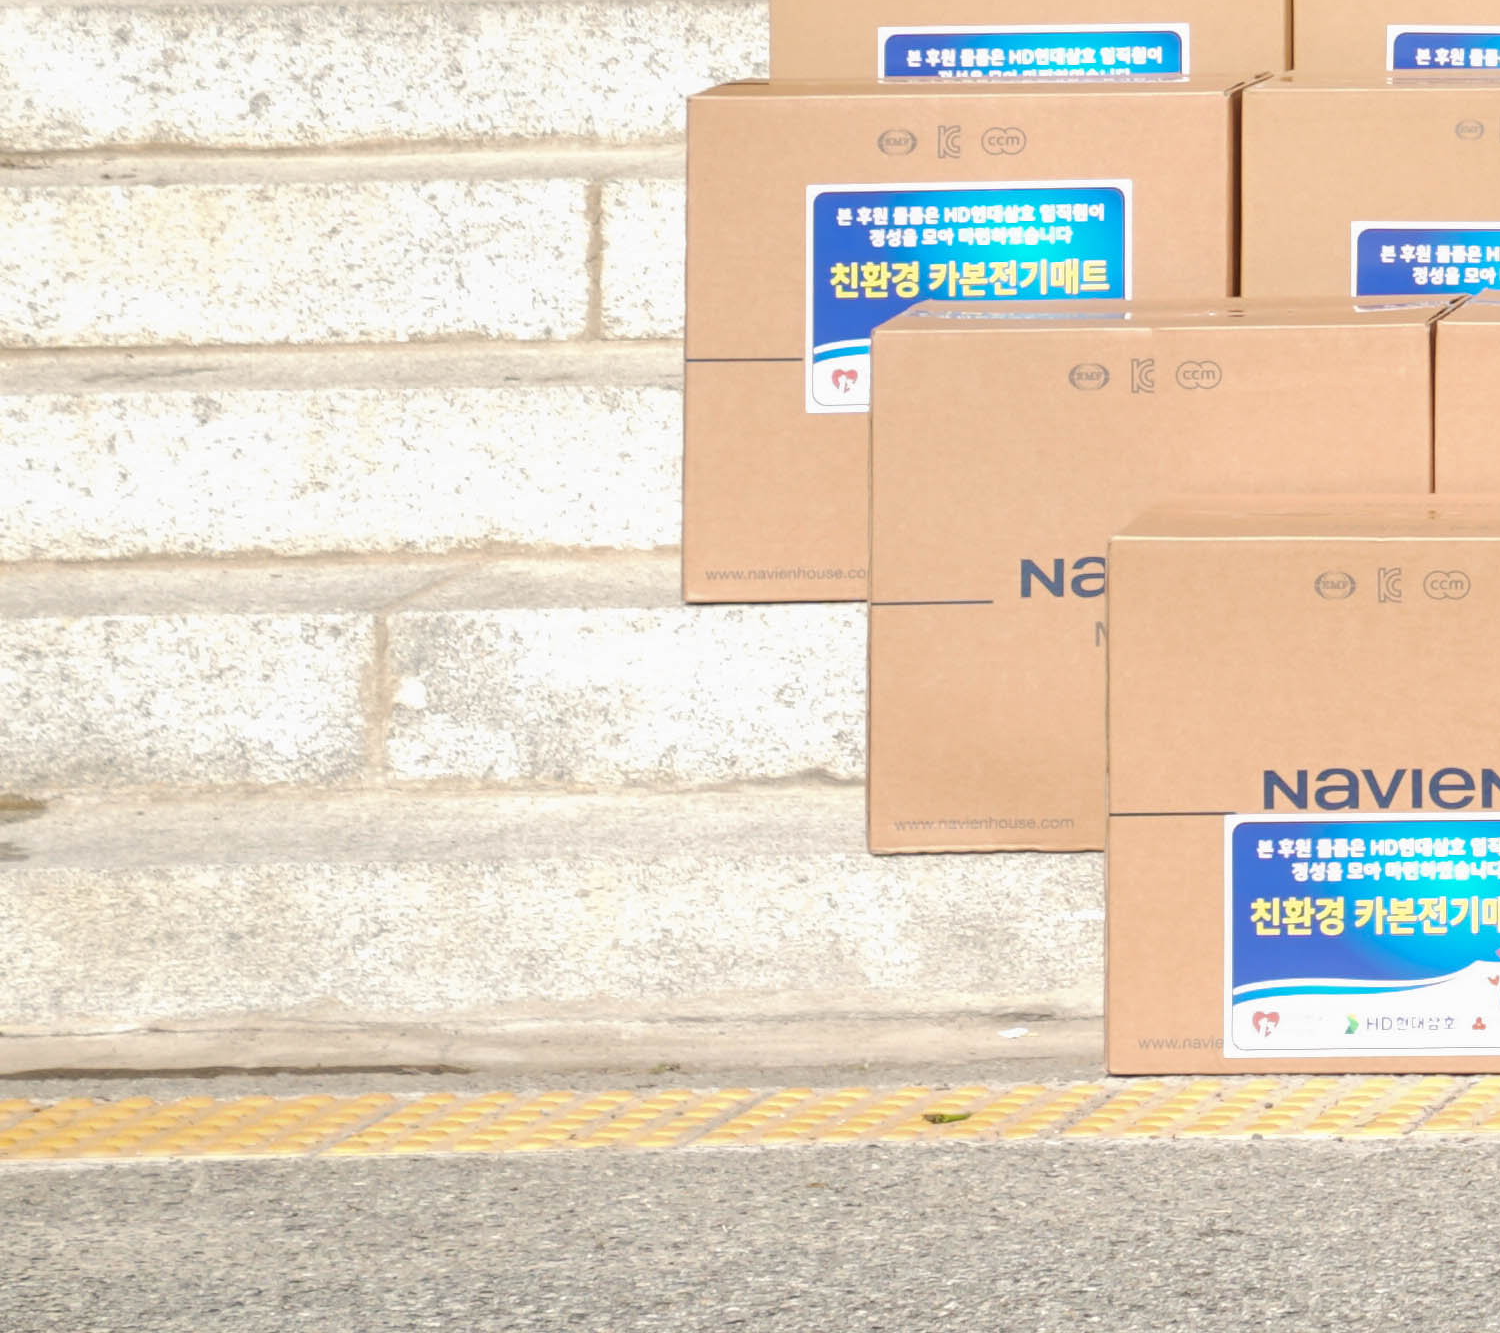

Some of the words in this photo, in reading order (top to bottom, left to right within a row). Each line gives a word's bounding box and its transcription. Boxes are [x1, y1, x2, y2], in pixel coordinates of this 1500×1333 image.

[831, 262, 921, 301] 친환경
[929, 258, 1112, 299] 카본전기매트
[705, 567, 868, 580] www.navienhouse.co
[1249, 897, 1343, 936] 친환경
